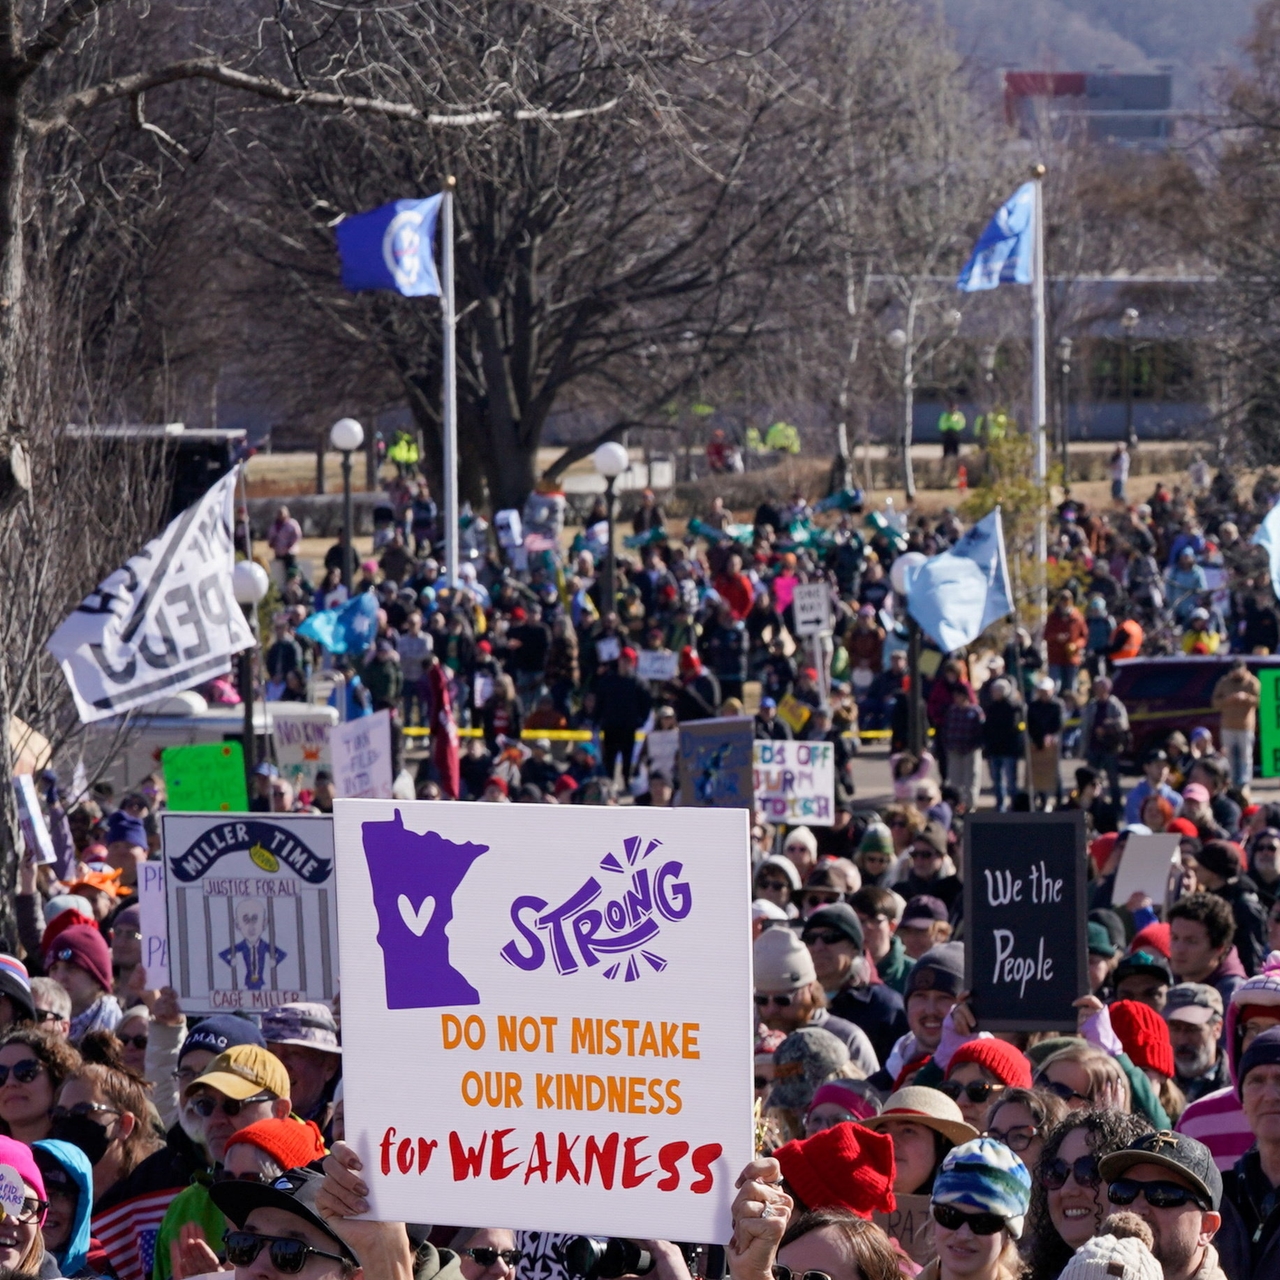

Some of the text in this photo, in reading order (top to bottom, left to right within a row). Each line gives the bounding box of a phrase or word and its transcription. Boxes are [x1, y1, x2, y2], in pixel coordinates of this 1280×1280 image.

[181, 822, 250, 878] MILLER
[269, 830, 319, 879] TIME
[205, 879, 299, 896] JUSTICE FOR ALL
[985, 860, 1063, 907] We the
[500, 861, 693, 976] STRONG
[993, 928, 1054, 998] People
[212, 990, 300, 1008] CAGE MILLER
[441, 1014, 701, 1060] DO NOT MISTAKE
[461, 1070, 683, 1115] OUR KINDNESS
[379, 1127, 723, 1194] for WEAKNESS
